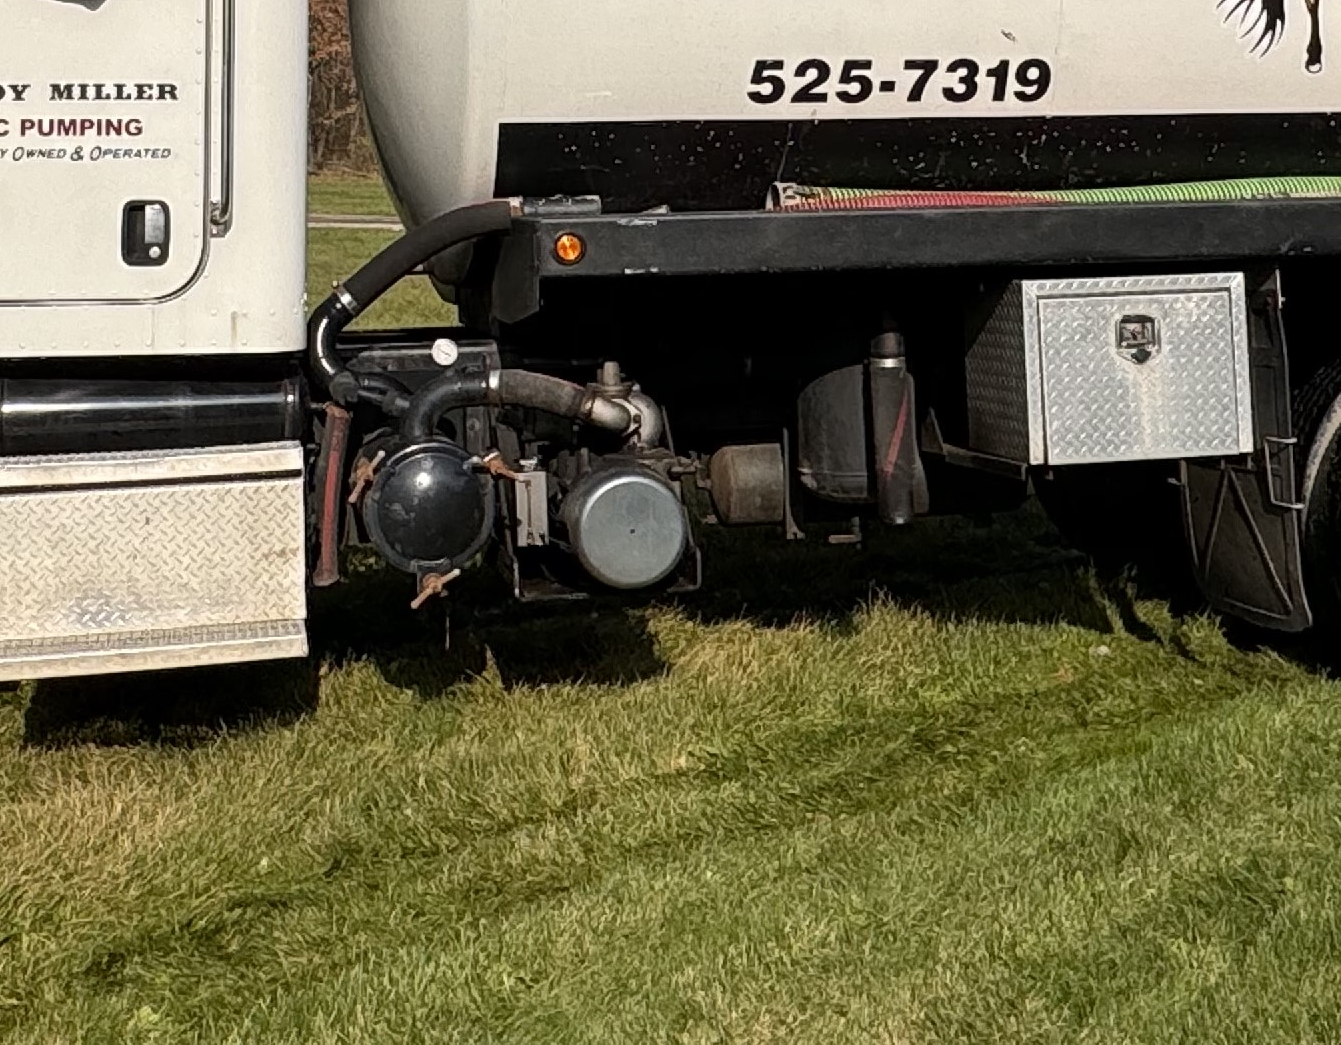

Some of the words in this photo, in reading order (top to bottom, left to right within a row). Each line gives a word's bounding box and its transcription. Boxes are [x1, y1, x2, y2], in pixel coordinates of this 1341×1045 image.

[48, 82, 179, 101] MILLER
[746, 58, 1053, 105] 525-7319
[20, 117, 144, 138] PUMPING
[69, 145, 85, 162] &
